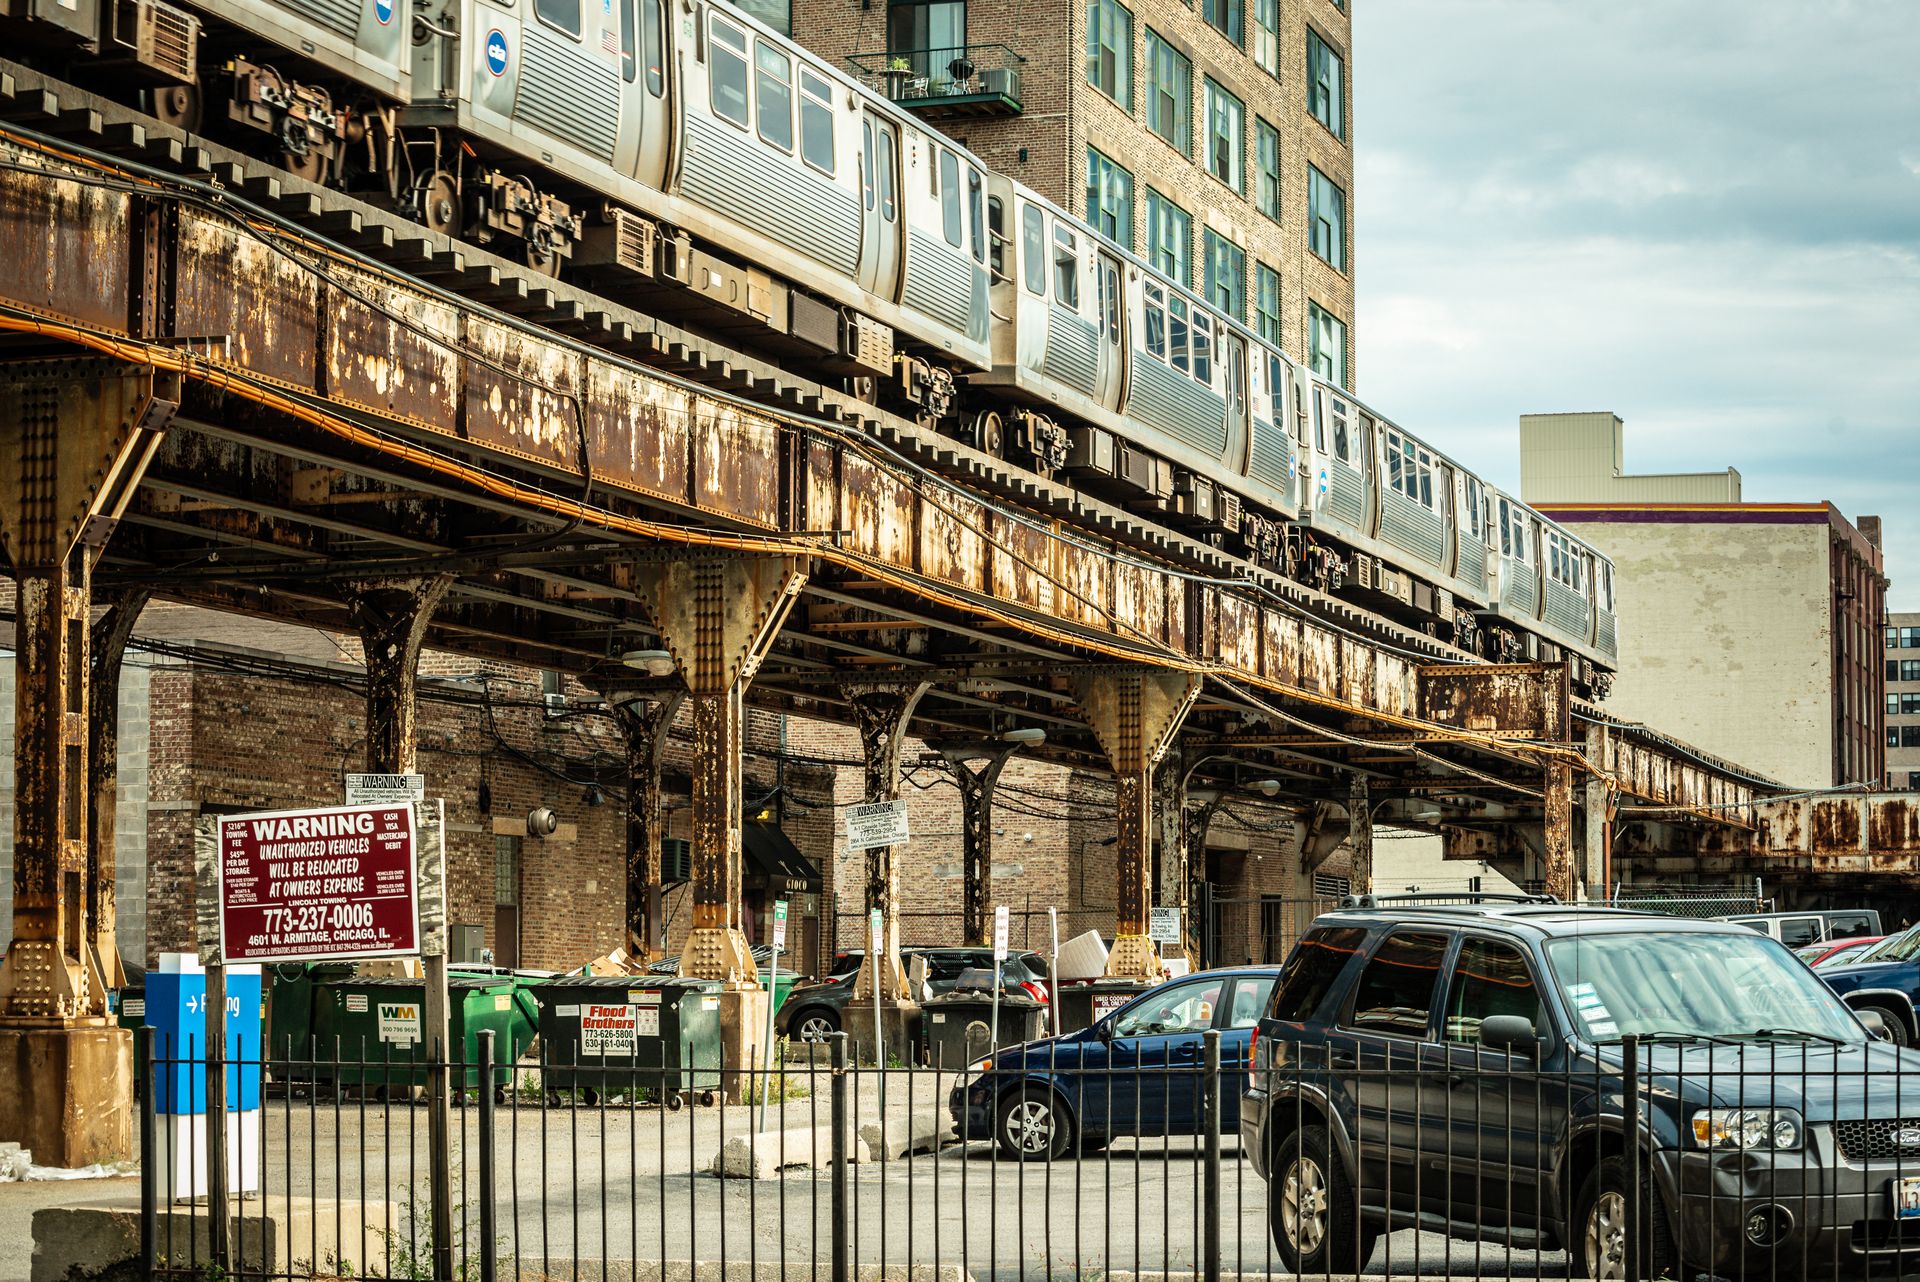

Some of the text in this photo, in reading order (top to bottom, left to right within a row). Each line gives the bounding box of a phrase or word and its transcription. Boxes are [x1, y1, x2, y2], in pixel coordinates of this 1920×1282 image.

[363, 776, 406, 788] WARNING
[857, 802, 894, 817] WARNING
[383, 813, 399, 821] CASH
[252, 813, 375, 842] WARNING
[385, 822, 399, 831] VISA
[226, 830, 248, 839] TOWING
[376, 832, 408, 840] MASTERCARD
[232, 839, 242, 847] FEE
[385, 841, 402, 850] DEBIT
[260, 837, 370, 861] UNAUTHORIZED VEHICLES
[226, 858, 249, 868] PER DAY
[269, 857, 359, 879] WILL BE RELOCATED
[226, 867, 250, 876] STORAGE
[269, 876, 365, 898] AT OWNERS EXPENSE
[786, 879, 807, 890] GIOCO
[288, 897, 347, 907] LINCOLN TOWING
[263, 903, 374, 933] 773-237-0006
[1151, 909, 1169, 917] NING
[248, 927, 391, 946] 4601 W. ARMITAGE, CHICAGO, IL.
[298, 945, 318, 954] REGULATED
[381, 1006, 416, 1018] WM
[589, 1005, 627, 1017] Flood
[582, 1017, 636, 1029] Brothers
[1899, 1131, 1920, 1144] Ford
